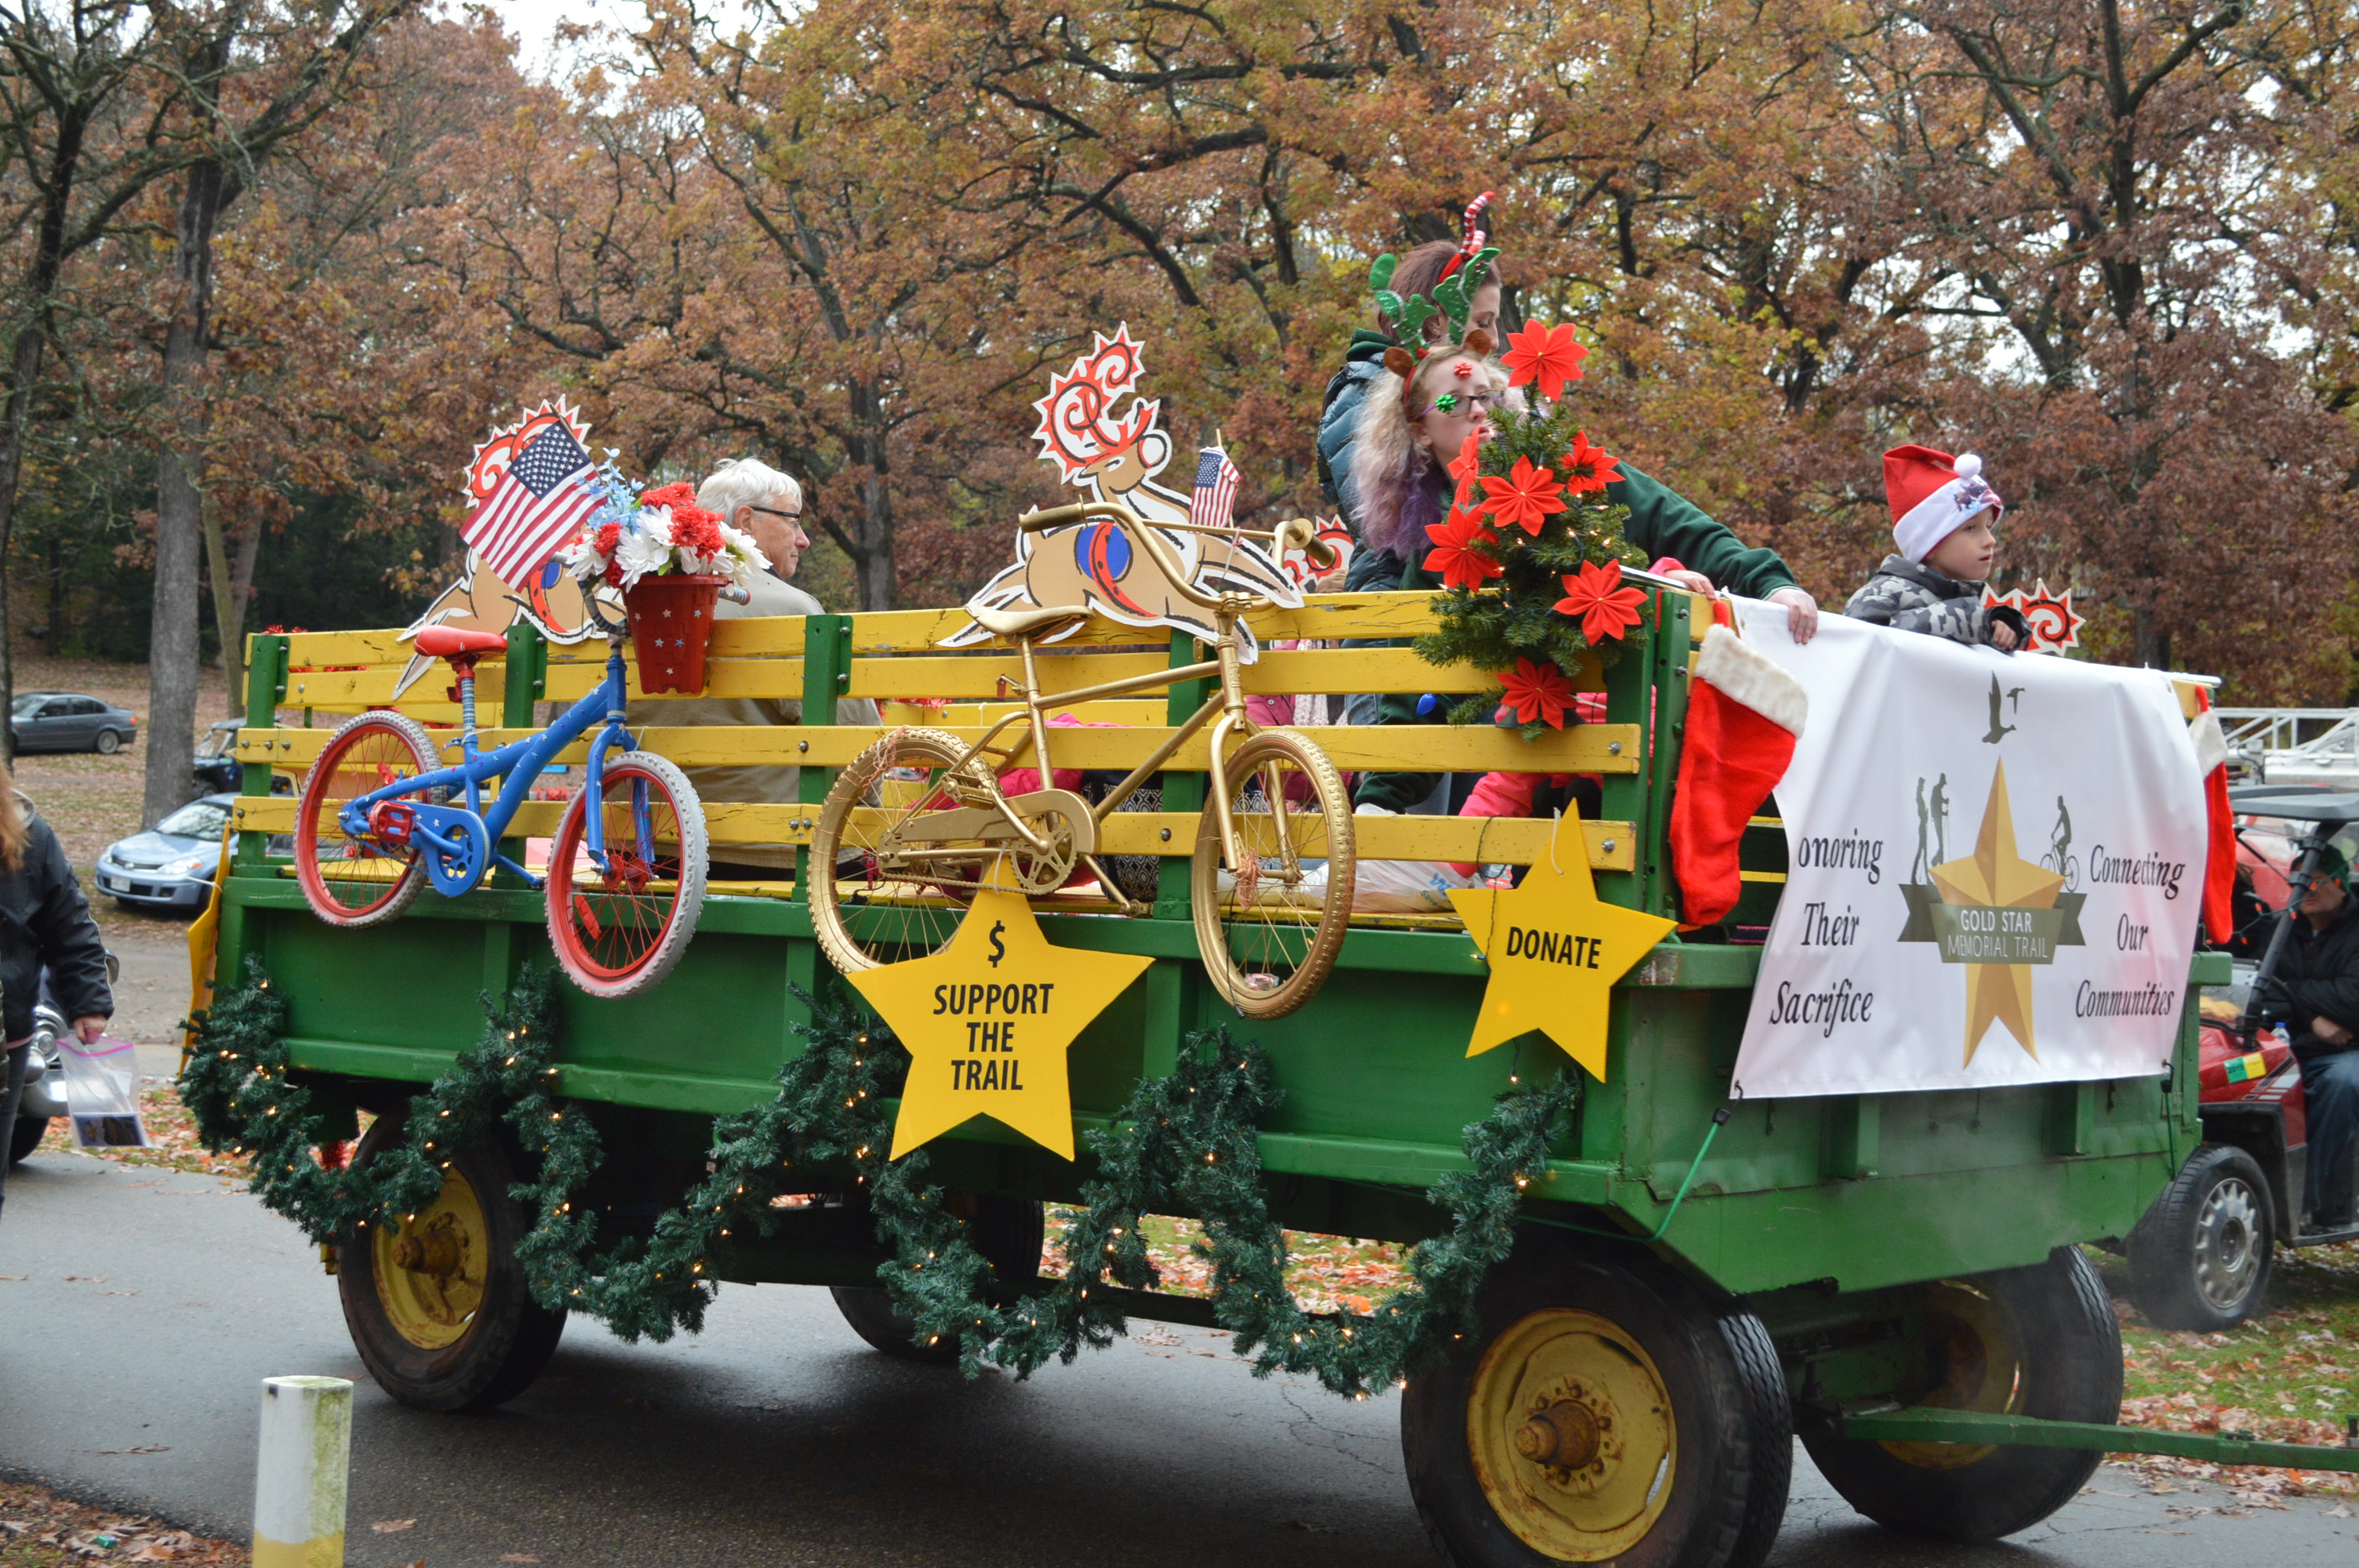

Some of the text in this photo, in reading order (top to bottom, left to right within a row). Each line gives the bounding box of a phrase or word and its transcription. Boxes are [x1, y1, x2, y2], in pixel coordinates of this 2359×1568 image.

[1798, 828, 1883, 885] onoring
[2090, 844, 2185, 900] Connecting
[1801, 902, 1859, 946] Their
[1961, 909, 2032, 933] GOLD STAR
[2117, 913, 2148, 951] Our
[987, 920, 1006, 968] $
[1506, 927, 1602, 970] DONATE
[1947, 935, 2048, 958] MEMORIAL TRAIL
[932, 983, 1054, 1015] SUPPORT
[1768, 978, 1874, 1038] Sacrifice
[2075, 979, 2175, 1018] Communities
[966, 1022, 1015, 1052] THE
[951, 1060, 1023, 1091] TRAIL
